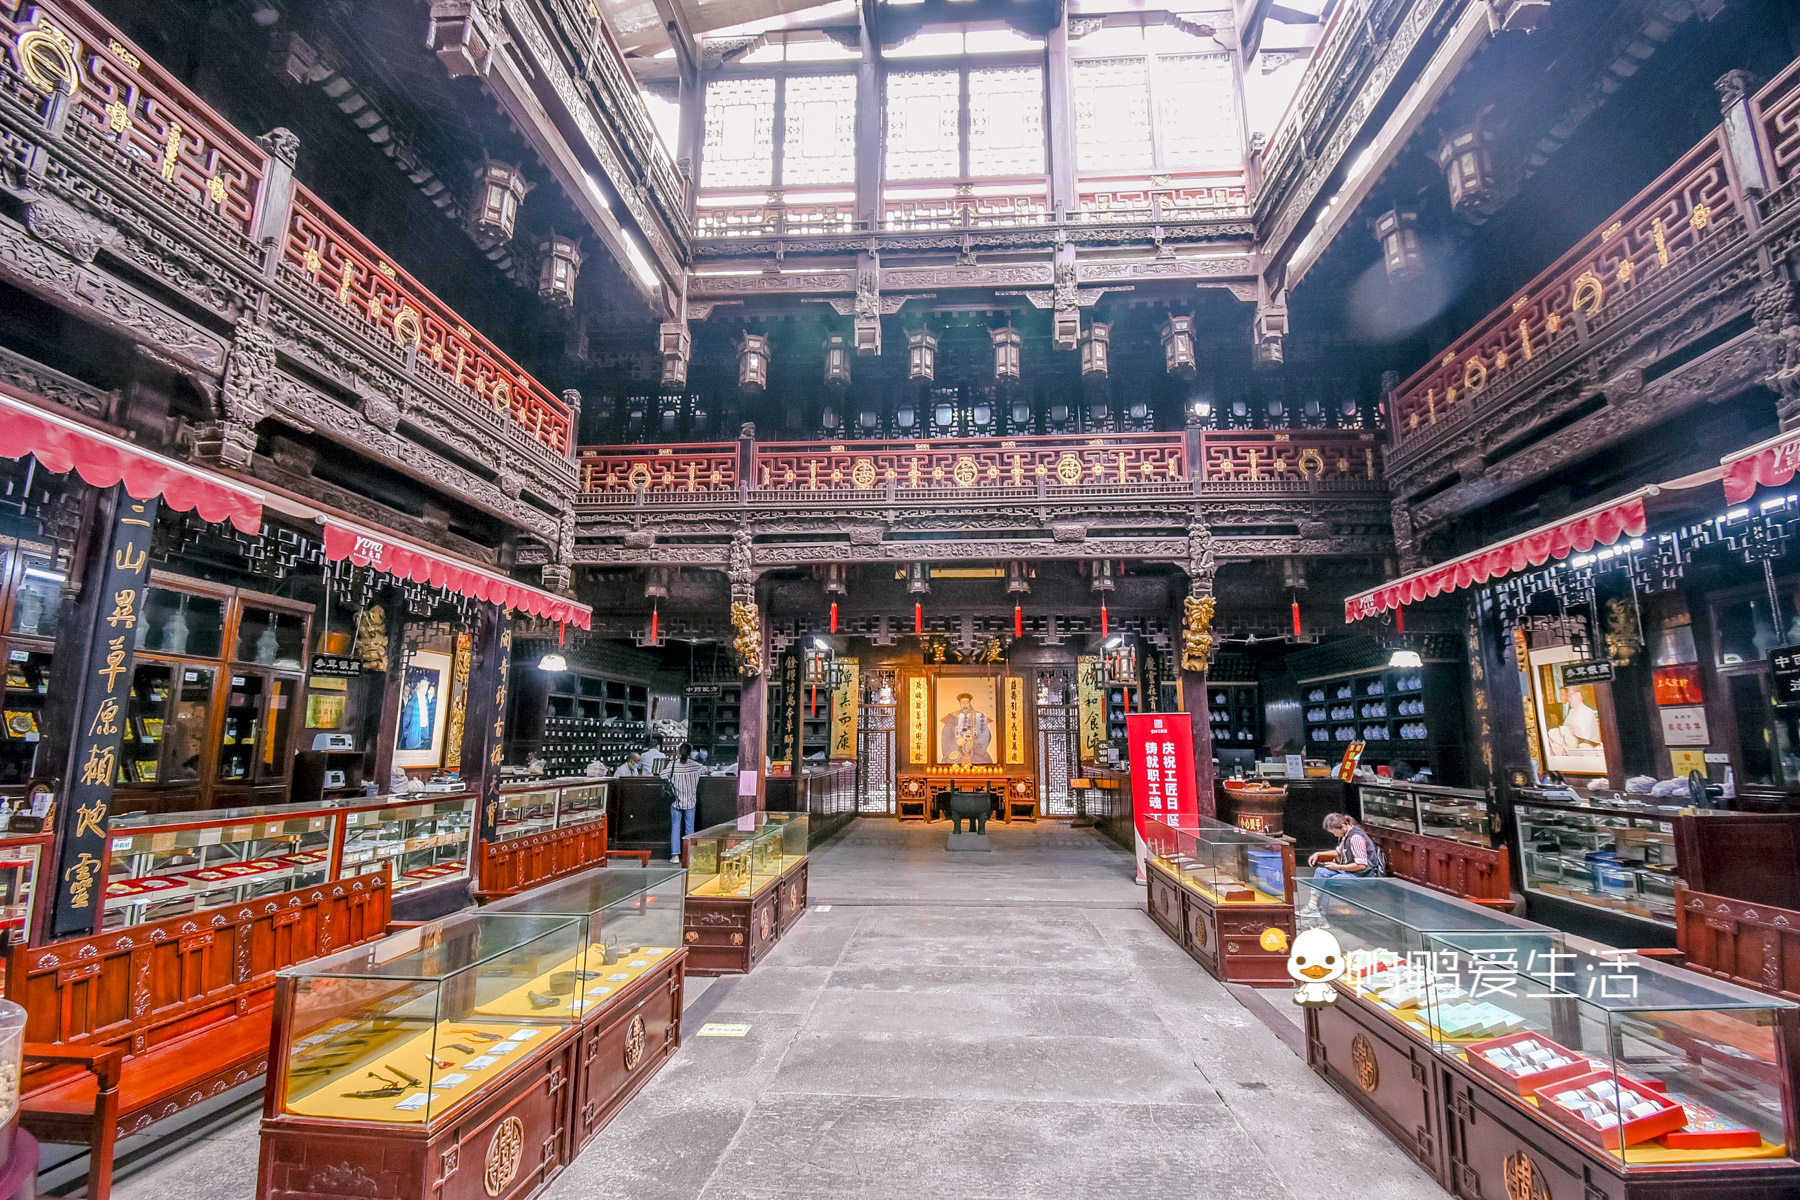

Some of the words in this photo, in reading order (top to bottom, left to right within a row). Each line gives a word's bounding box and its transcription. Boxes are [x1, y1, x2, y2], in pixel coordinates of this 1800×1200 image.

[1145, 742, 1162, 810] 铸就职工魂
[1162, 742, 1178, 810] 庆祝工匠日
